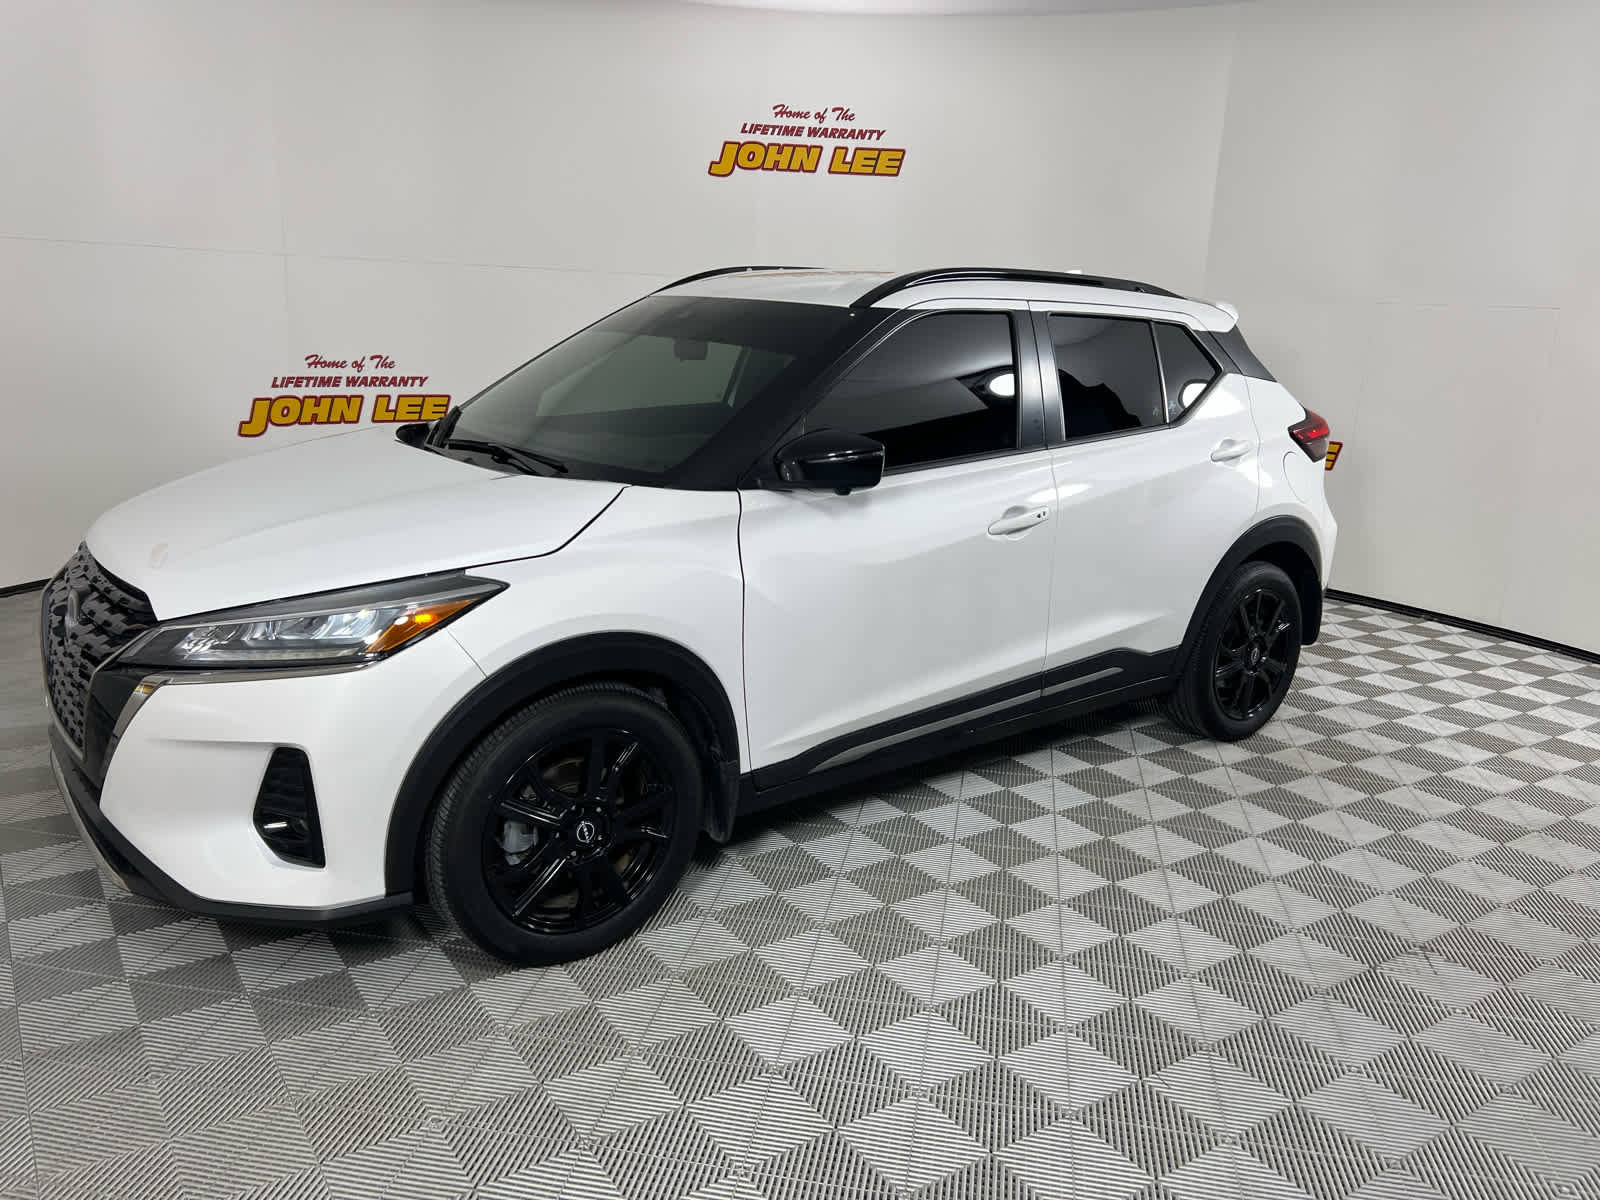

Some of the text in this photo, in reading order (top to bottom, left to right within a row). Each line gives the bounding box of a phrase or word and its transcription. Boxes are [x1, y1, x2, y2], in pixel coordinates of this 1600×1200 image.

[772, 104, 856, 124] Home of The
[740, 123, 886, 141] LIFETIME WARRANTY
[708, 141, 906, 178] JOHN LEE
[304, 354, 396, 373] Home of The
[271, 376, 429, 389] LIFETIME WARRANTY
[238, 394, 451, 437] JOHN LEE
